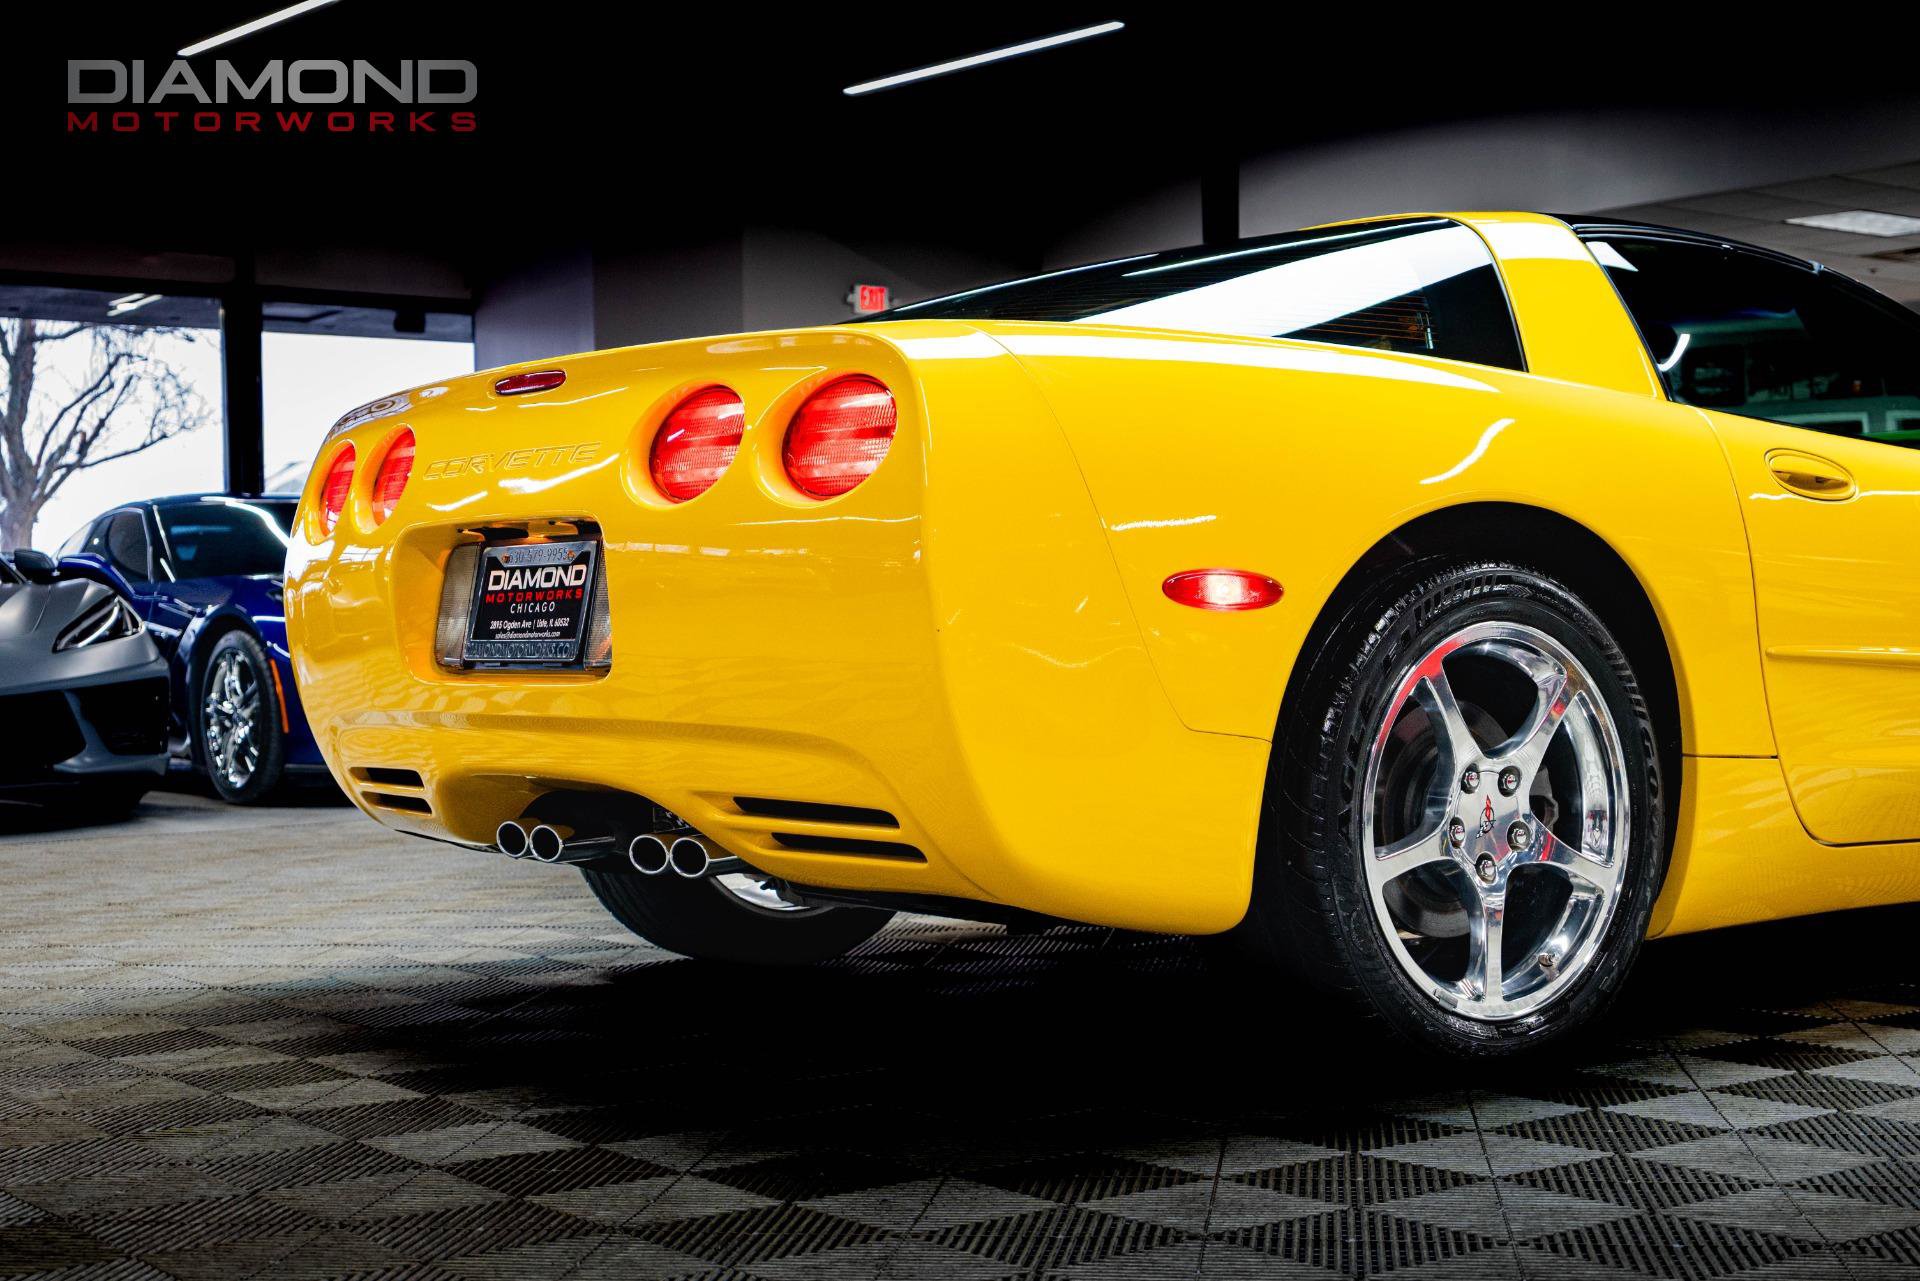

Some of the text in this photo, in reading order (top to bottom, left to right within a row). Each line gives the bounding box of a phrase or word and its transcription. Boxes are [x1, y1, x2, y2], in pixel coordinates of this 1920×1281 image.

[861, 287, 885, 309] EXIT
[423, 442, 601, 480] CORVETTE
[488, 564, 587, 591] DIAMOND
[485, 588, 583, 604] MOTORWORKS
[510, 602, 555, 614] CHICAGO
[490, 621, 502, 630] 2895
[503, 619, 522, 631] Ogden
[522, 619, 532, 629] Ave
[495, 631, 560, 639] sales@diamondmotorworks.com
